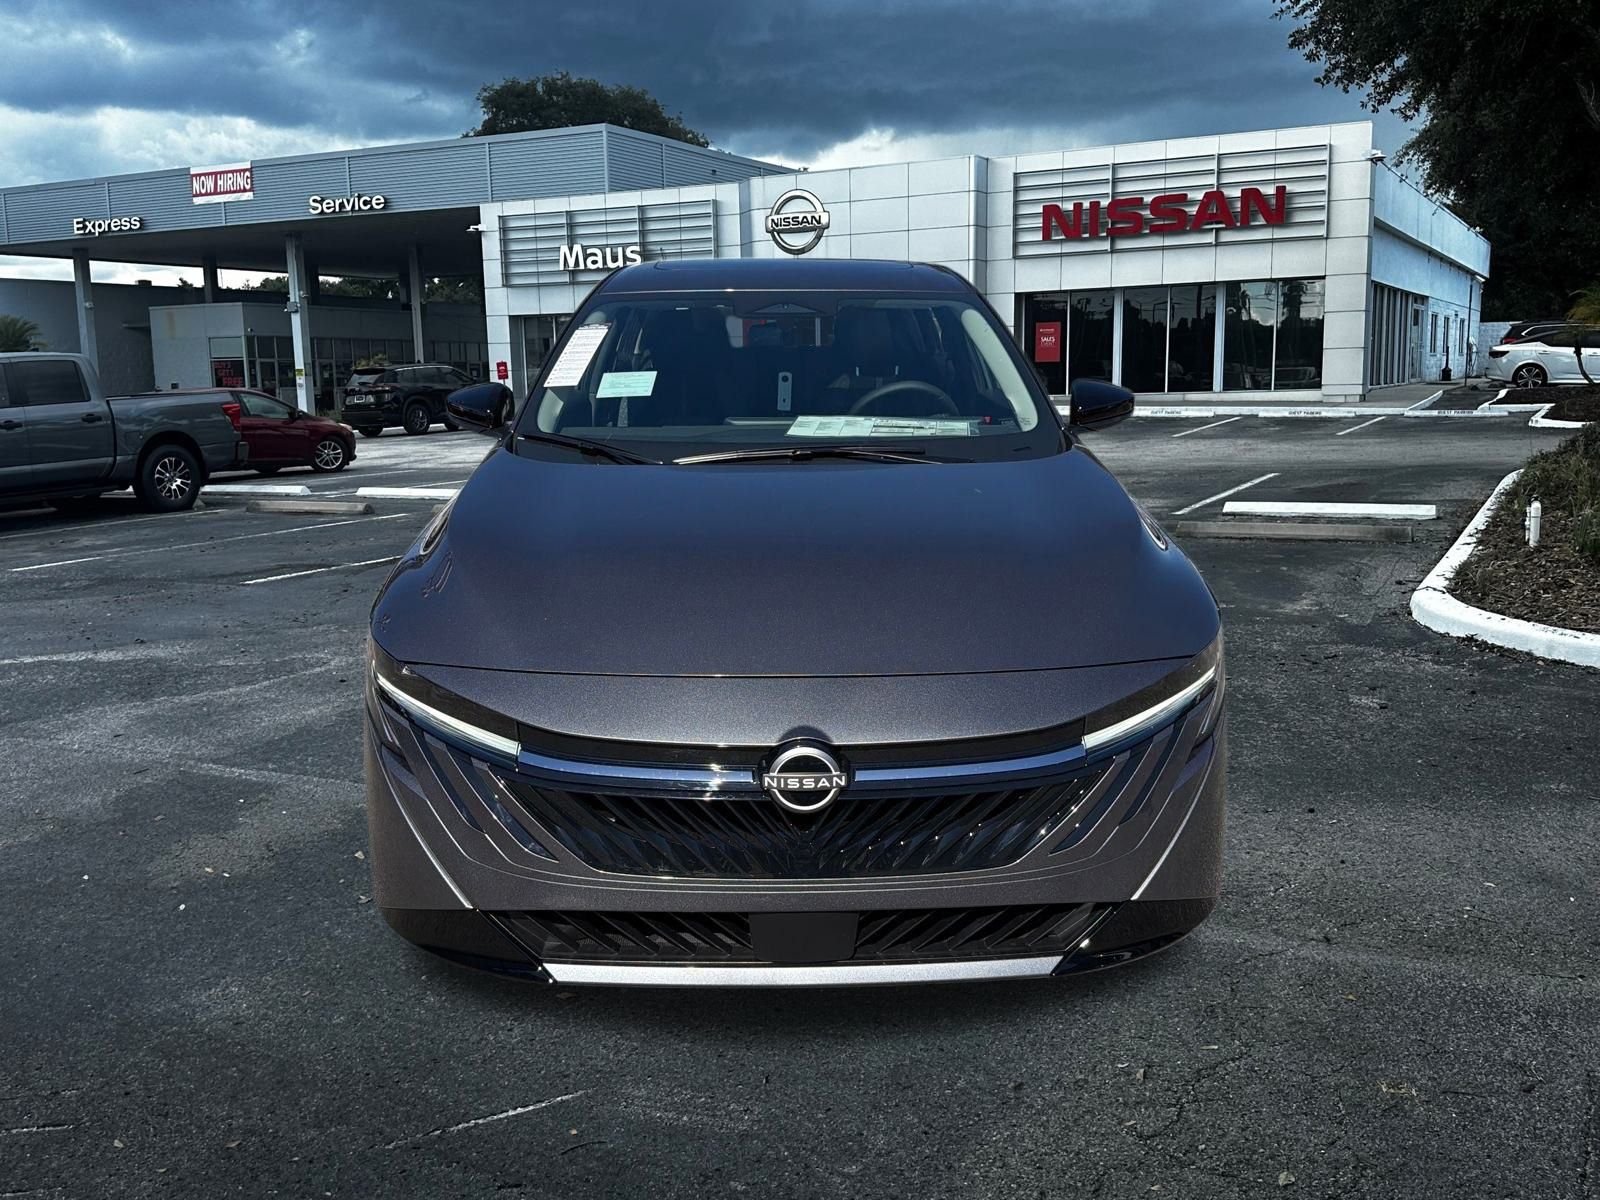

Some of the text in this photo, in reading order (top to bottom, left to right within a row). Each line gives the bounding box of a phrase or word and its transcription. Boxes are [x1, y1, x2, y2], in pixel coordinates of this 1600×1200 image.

[192, 171, 251, 195] NOW HIRING
[309, 192, 385, 214] Service
[1042, 184, 1287, 241] NISSAN
[73, 216, 141, 236] Express
[771, 215, 821, 228] NISSAN
[559, 243, 642, 270] Maus
[764, 775, 846, 788] NISSAN
